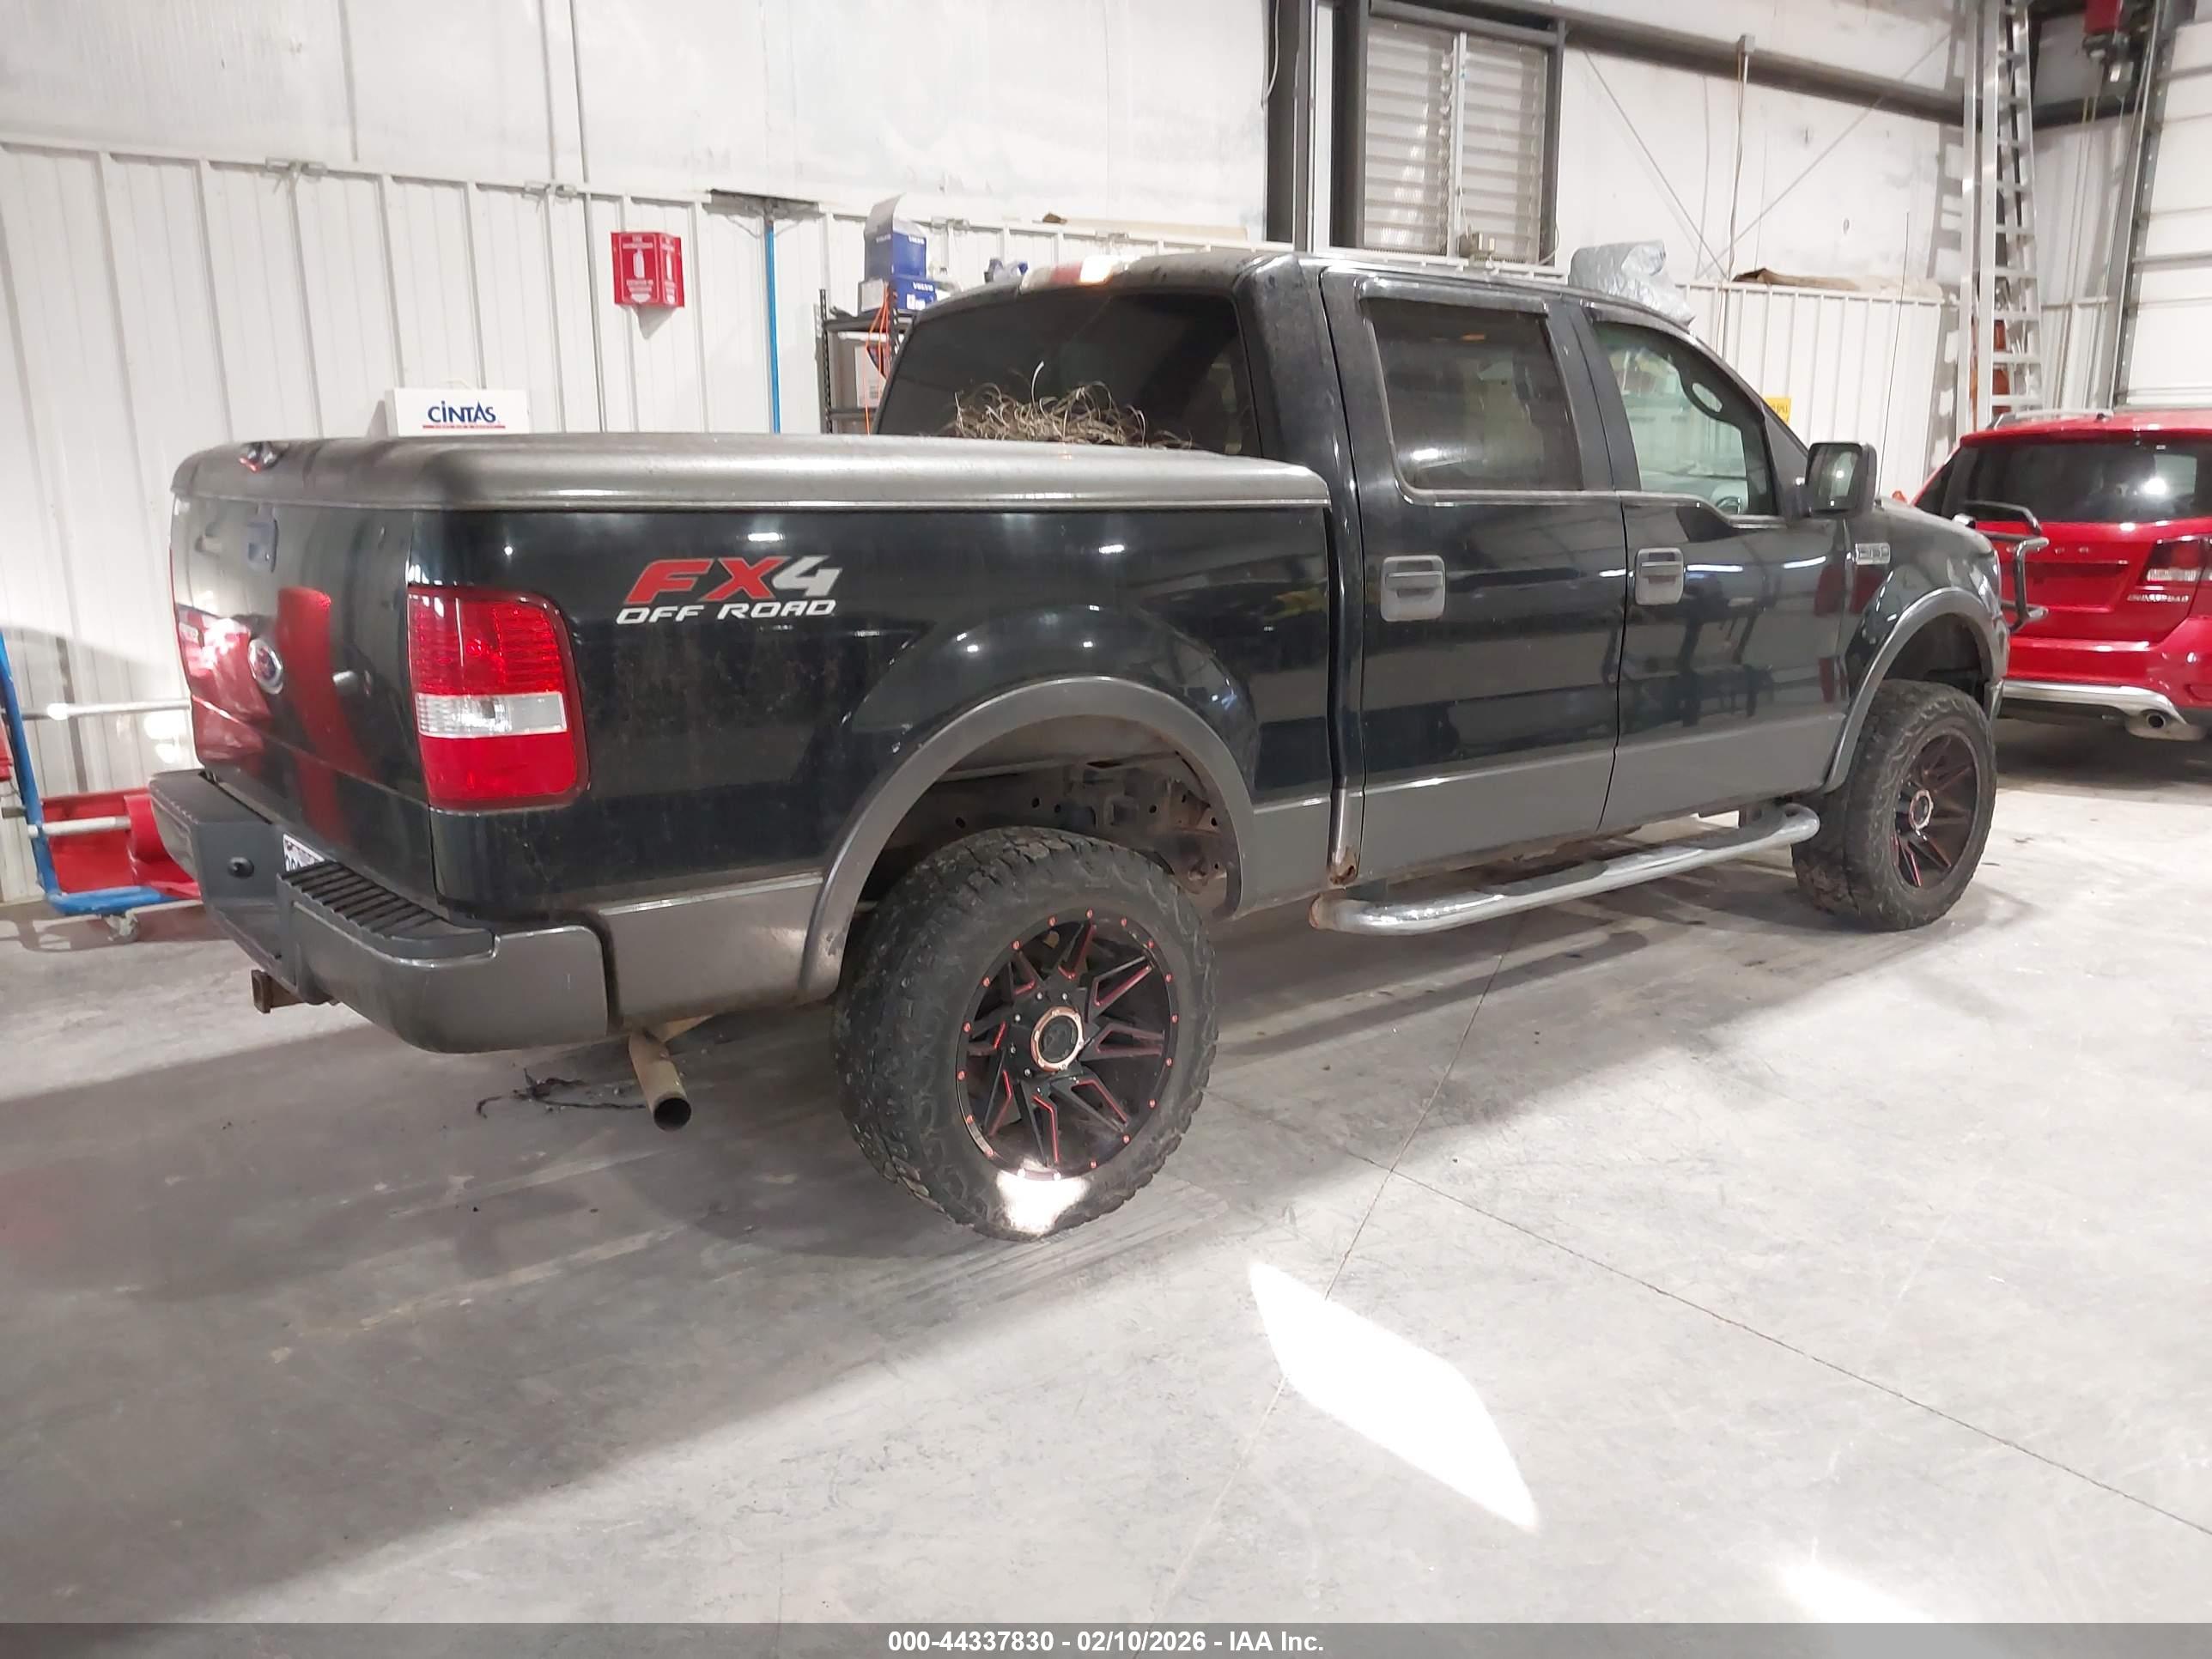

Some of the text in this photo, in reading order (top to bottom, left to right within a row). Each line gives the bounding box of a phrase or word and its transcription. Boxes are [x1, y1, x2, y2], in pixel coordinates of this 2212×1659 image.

[624, 555, 842, 605] FX4
[616, 599, 837, 624] OFF ROAD
